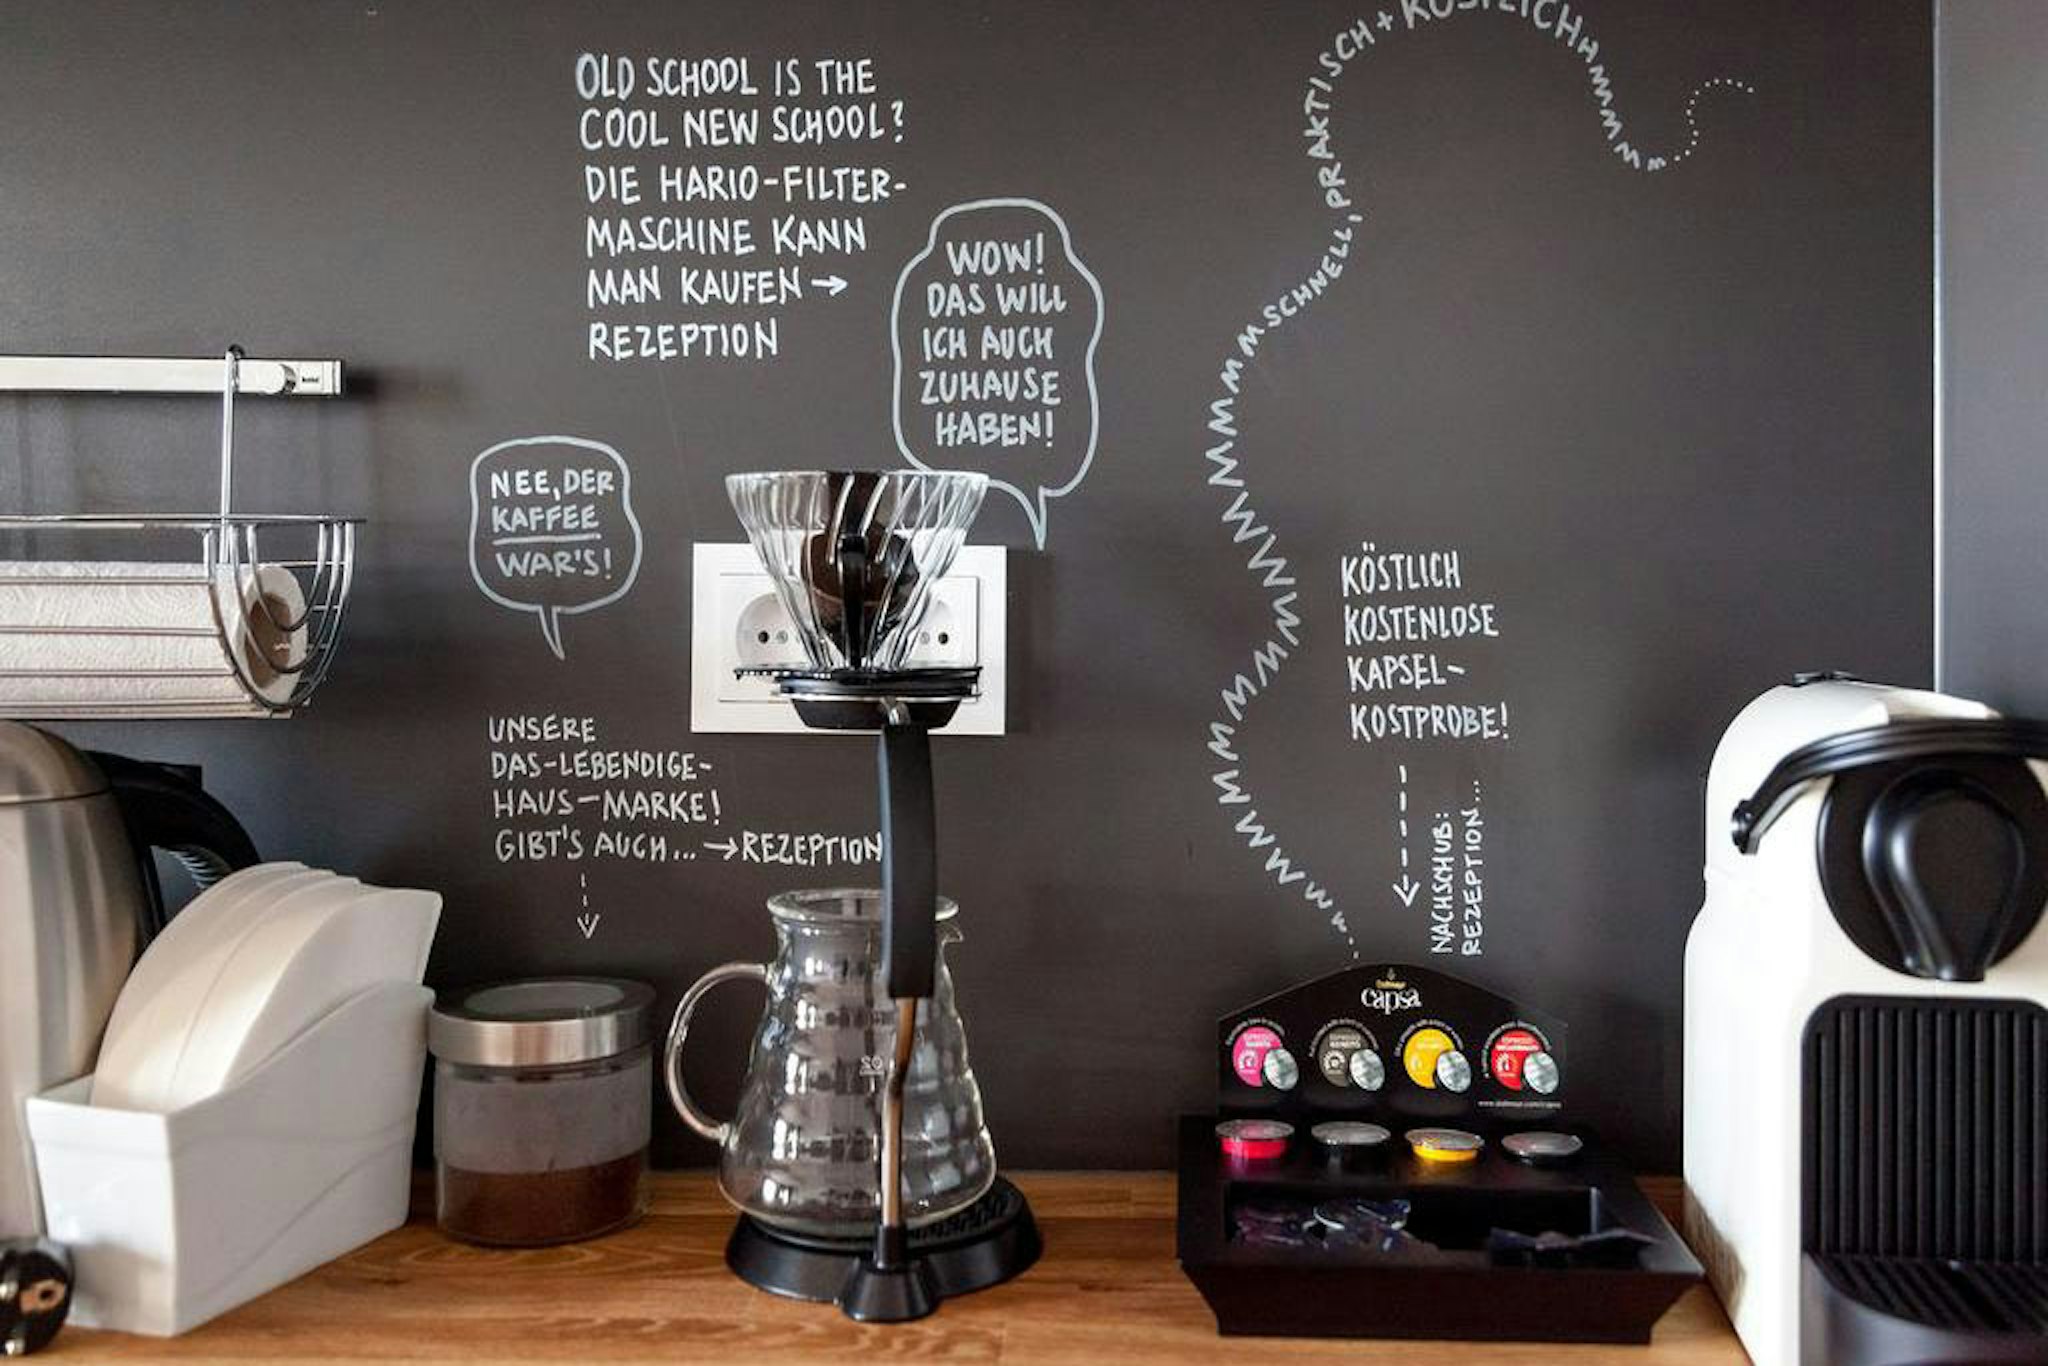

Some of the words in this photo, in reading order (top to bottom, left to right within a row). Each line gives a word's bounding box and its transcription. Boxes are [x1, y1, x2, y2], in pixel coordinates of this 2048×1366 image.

[576, 53, 635, 100] OLD
[647, 57, 758, 97] SCHOOL
[775, 58, 801, 96] IS
[815, 59, 876, 95] THE
[580, 107, 669, 150] COOL
[684, 108, 758, 148] NEW
[773, 100, 903, 145] SCHOOL?
[1304, 20, 1375, 208] PRAKTISCH
[585, 165, 641, 205] DIE
[660, 165, 906, 203] HARIO-FILTER-
[587, 216, 756, 258] MASCHINE
[772, 214, 866, 257] KANN
[946, 233, 1043, 276] WOW!
[588, 265, 661, 308] MAN
[681, 266, 802, 305] KAUFEN
[1263, 215, 1362, 327] SCHNELL,
[928, 282, 985, 318] DAS
[996, 283, 1067, 315] WILL
[589, 318, 777, 361] REZEPTION
[923, 327, 967, 362] ICH
[982, 326, 1053, 360] AUCH
[919, 368, 1060, 405] ZUHAUSE
[936, 410, 1053, 447] HABEN!
[492, 505, 599, 535] KAFFEE
[496, 548, 611, 579] WAR'S!
[1341, 542, 1461, 597] KÖSTLICH
[1344, 603, 1499, 646] KOSTENLOSE
[1347, 654, 1465, 692] KAPSEL-
[489, 714, 596, 743] UNSERE
[1350, 702, 1509, 742] KOSTPROBE!
[491, 750, 712, 781] DAS-LEBENDIGE-
[496, 824, 582, 862] GIBT'S
[742, 830, 883, 866] REZEPTION
[1430, 813, 1455, 953] NACHSCHUB:
[1360, 986, 1422, 1015] capsa
